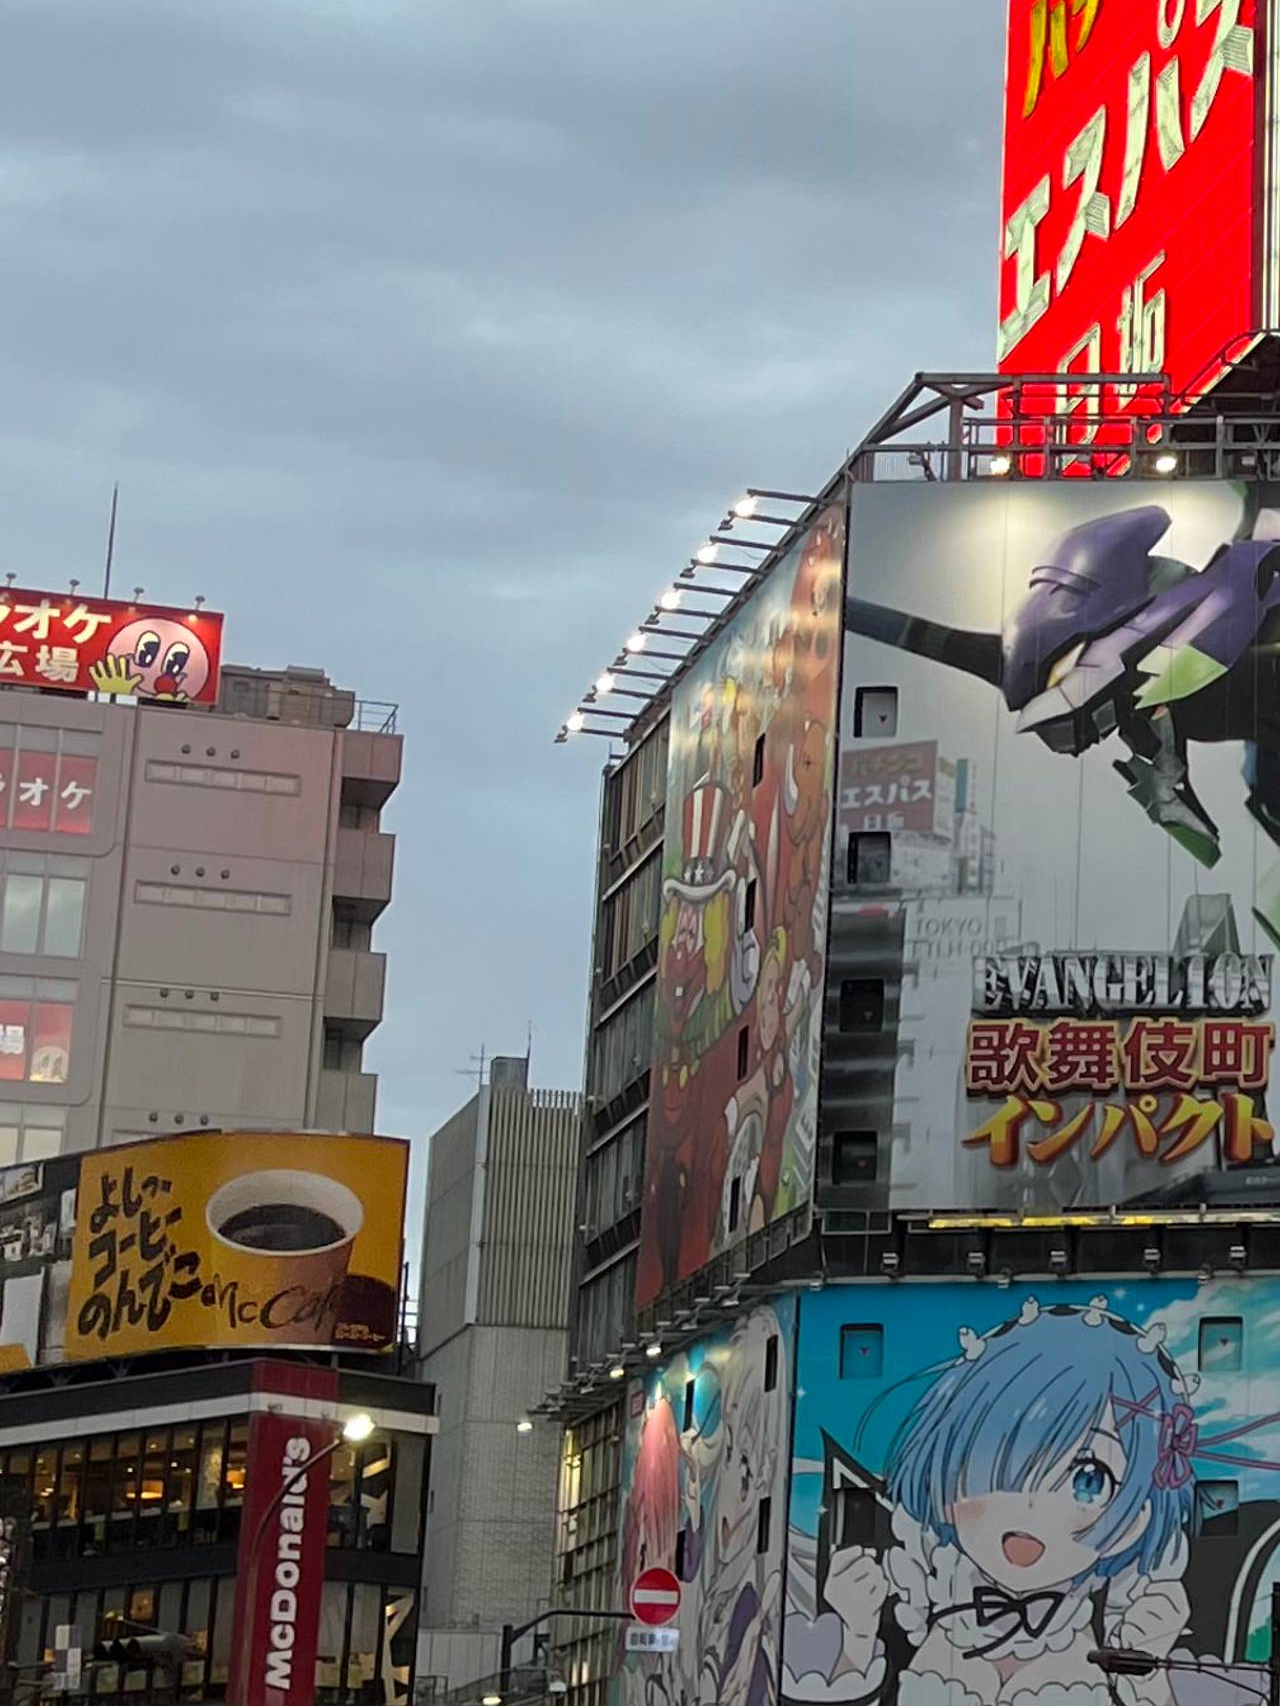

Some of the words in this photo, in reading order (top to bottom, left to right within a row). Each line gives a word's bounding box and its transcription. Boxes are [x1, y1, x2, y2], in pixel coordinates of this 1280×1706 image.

[0, 598, 112, 645] オケ
[0, 774, 92, 810] オケ
[840, 774, 932, 810] エスパス
[975, 951, 1276, 1015] EVANGELION
[967, 1017, 1276, 1090] 歌舞伎町
[961, 1092, 1276, 1165] インパクト
